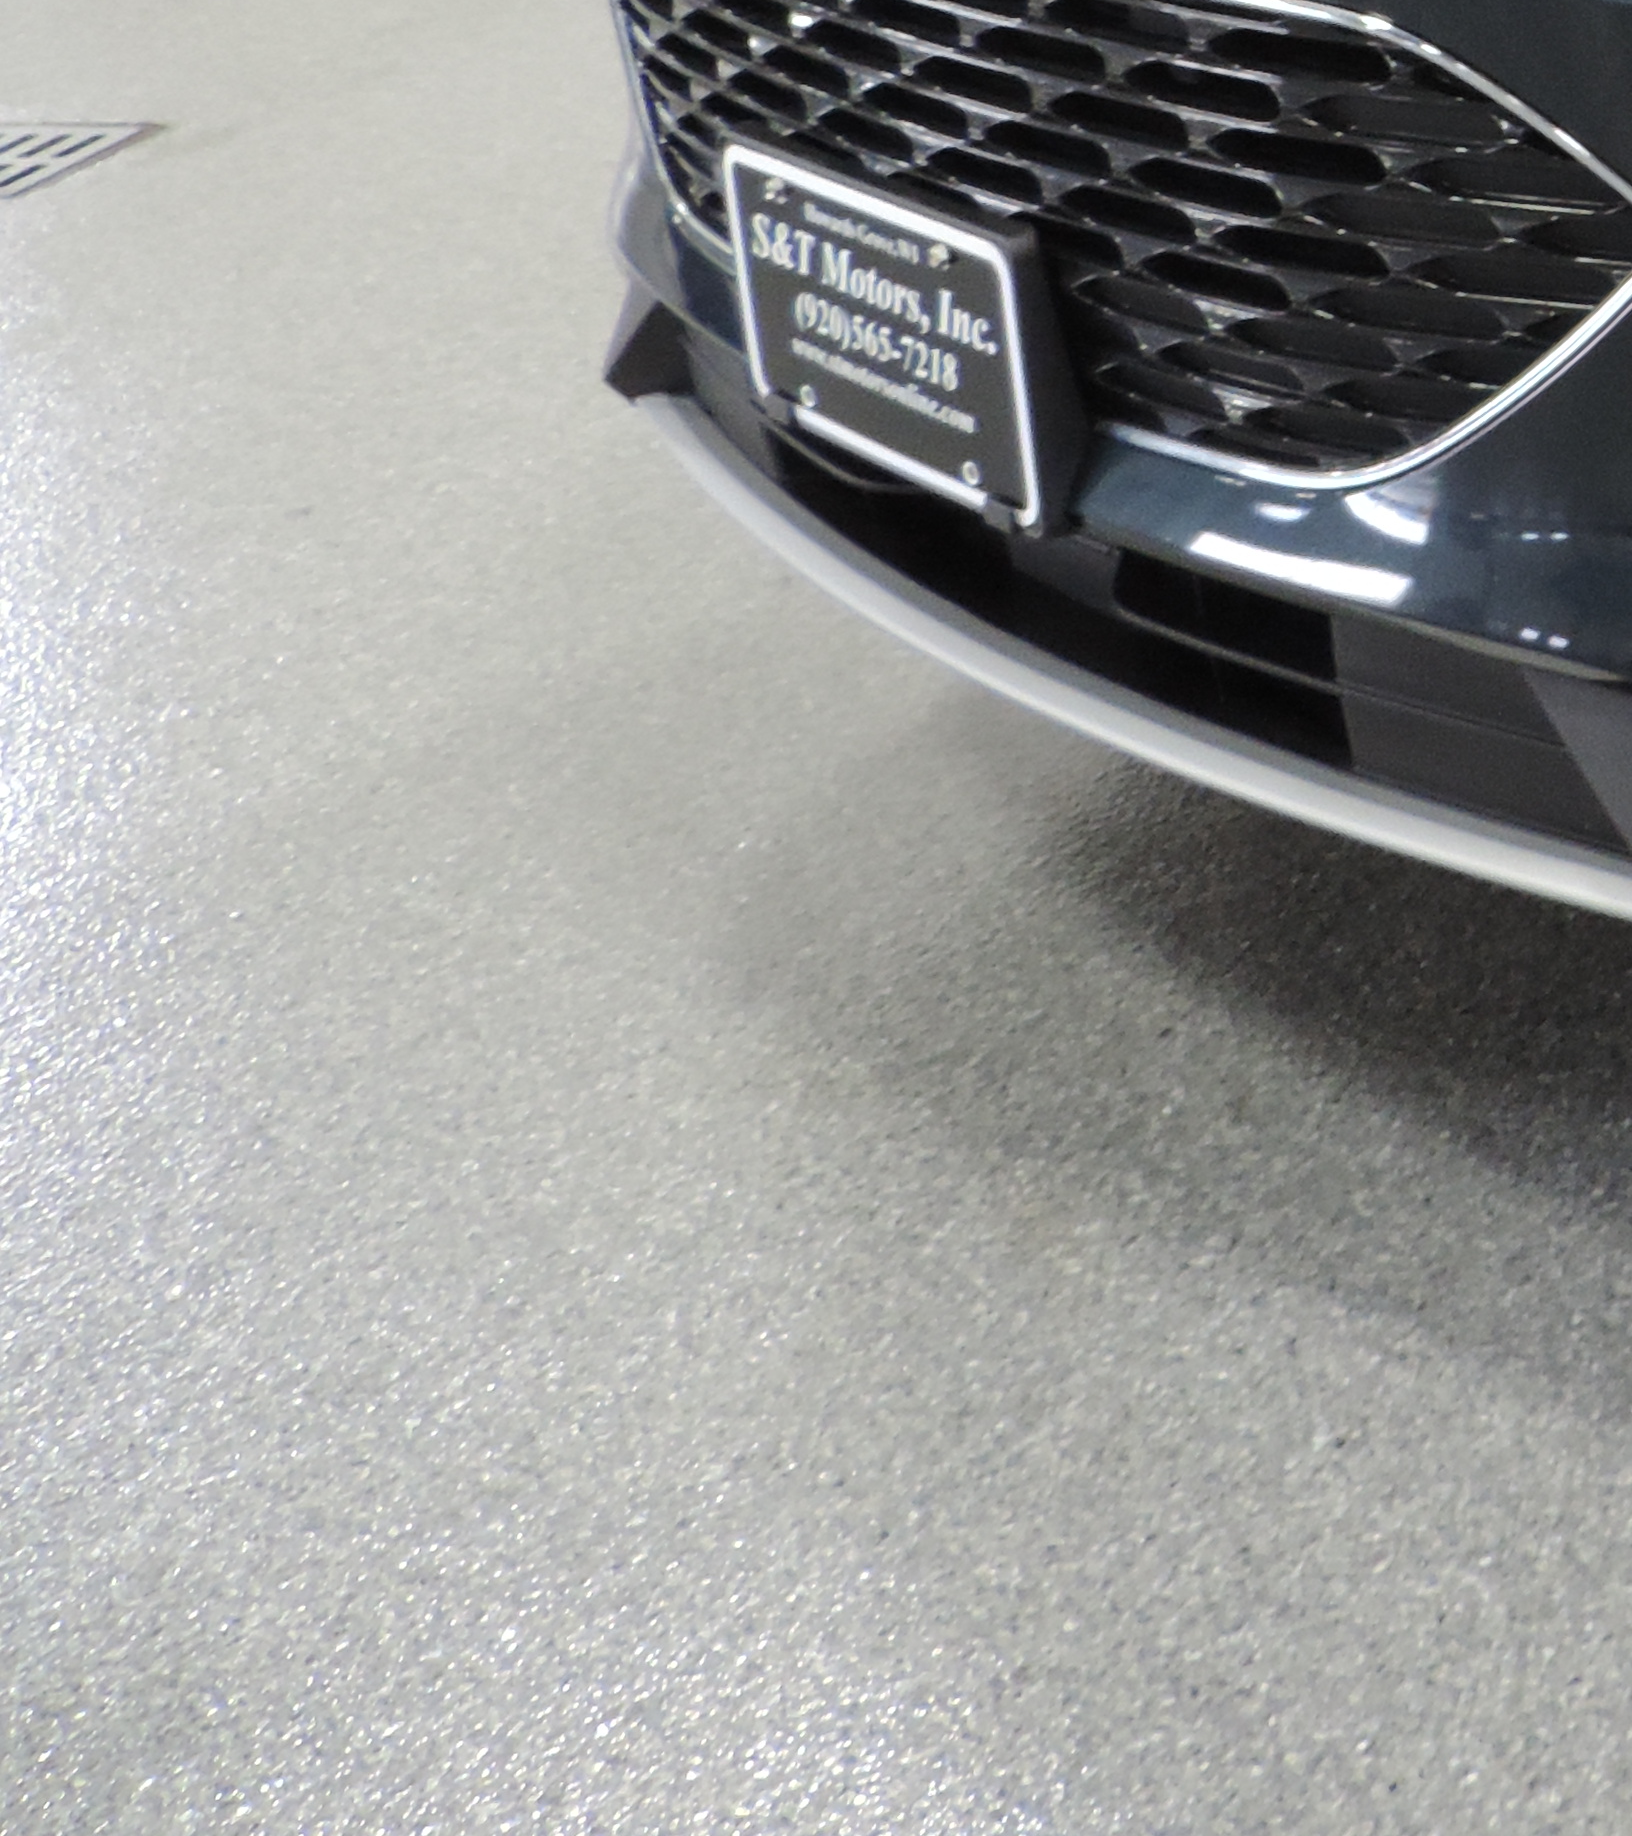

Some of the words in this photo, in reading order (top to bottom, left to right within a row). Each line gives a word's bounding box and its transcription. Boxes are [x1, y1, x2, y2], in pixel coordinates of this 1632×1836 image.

[751, 212, 816, 276] S&T
[821, 240, 931, 335] Motors,
[938, 289, 998, 355] Inc.
[794, 291, 960, 391] (920)565-7218
